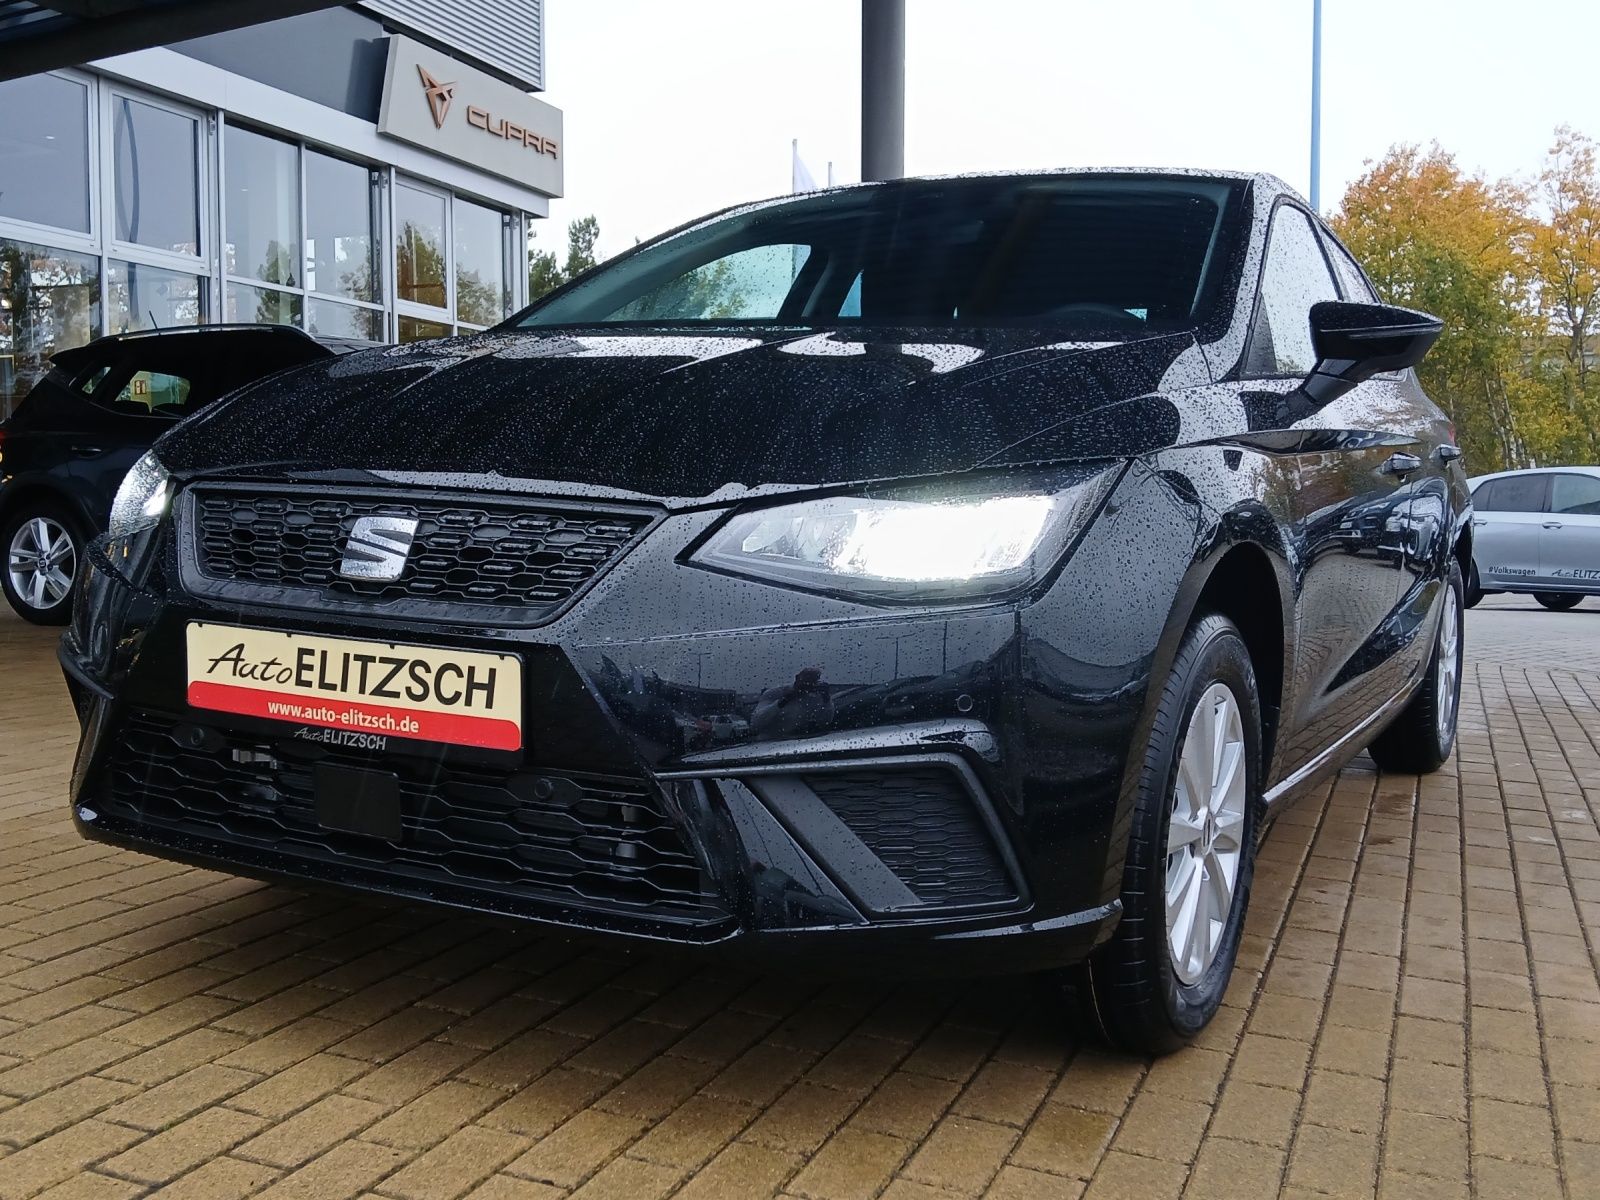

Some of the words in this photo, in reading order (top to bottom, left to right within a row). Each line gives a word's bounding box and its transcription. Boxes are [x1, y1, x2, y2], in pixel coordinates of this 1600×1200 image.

[466, 104, 558, 160] CUPRA
[1488, 566, 1536, 577] #Volkswagen
[267, 700, 420, 734] www.auto-elitzsch.de
